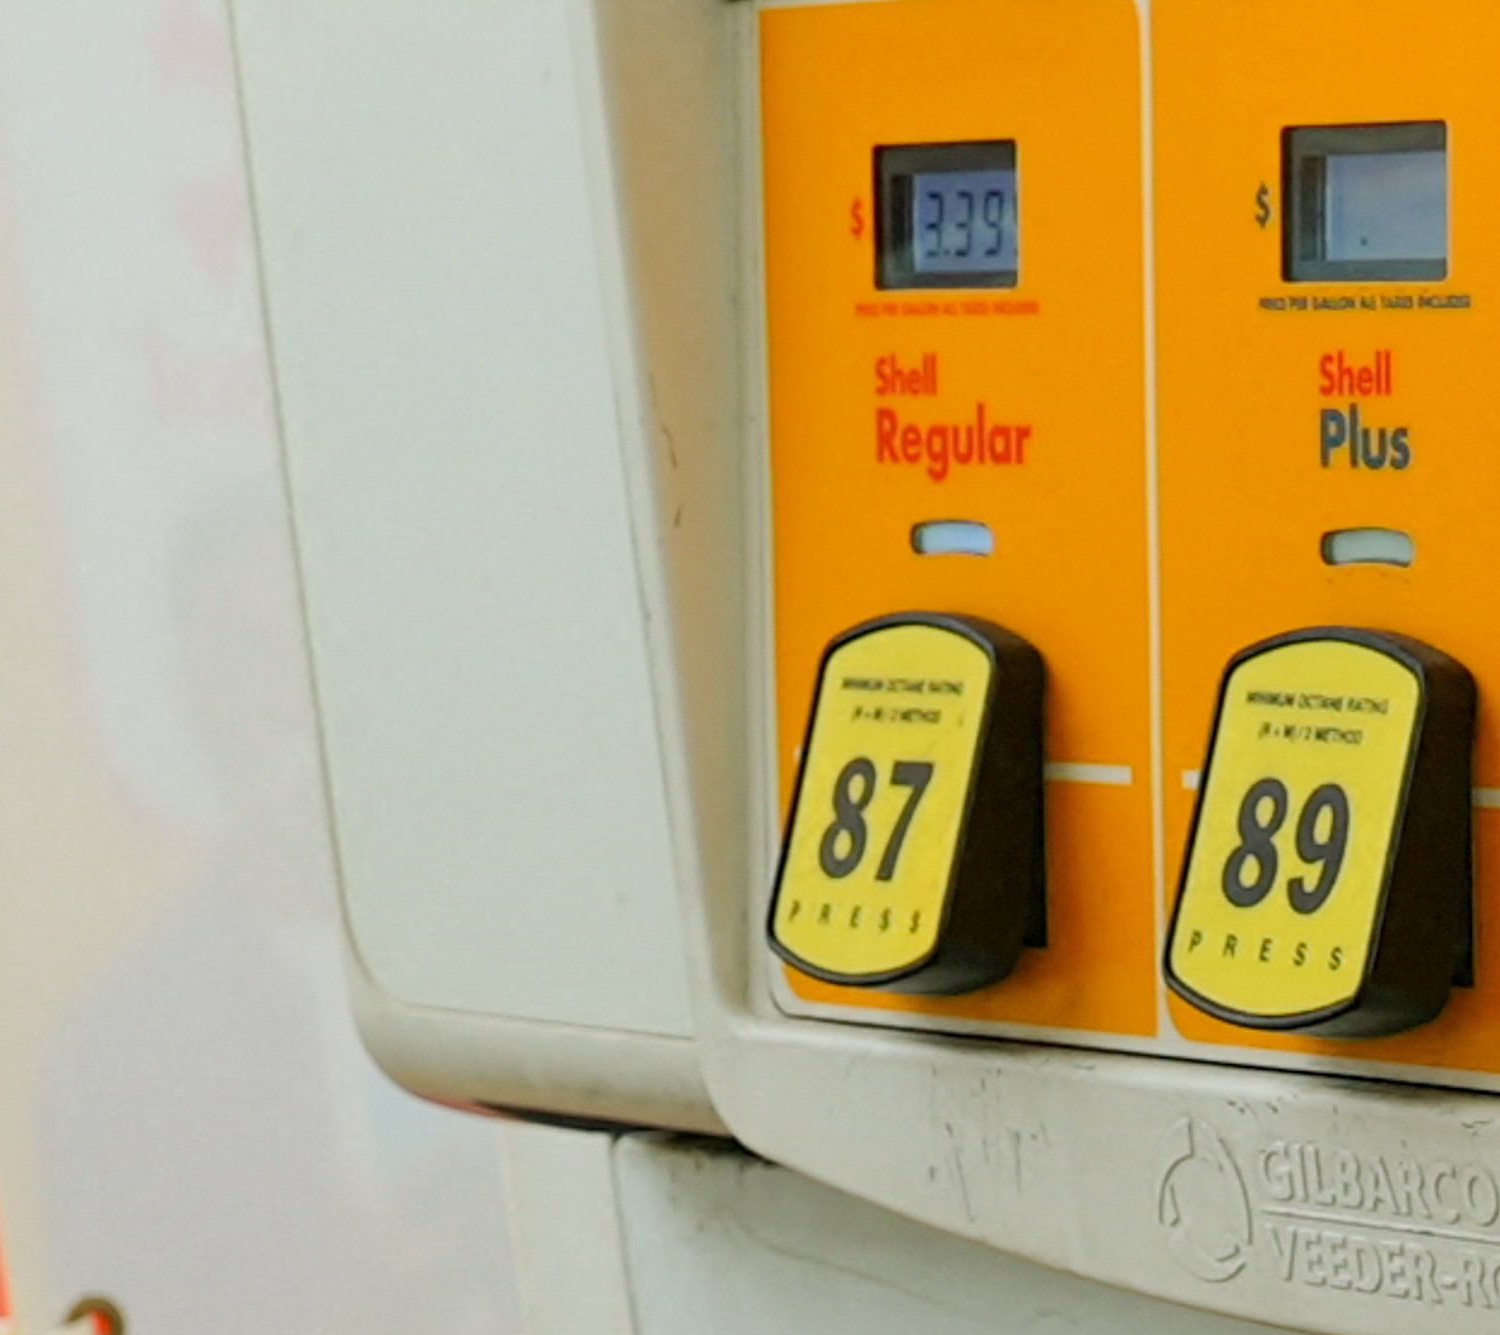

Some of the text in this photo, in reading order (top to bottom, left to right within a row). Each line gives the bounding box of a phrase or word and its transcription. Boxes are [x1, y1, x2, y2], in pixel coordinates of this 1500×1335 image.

[851, 196, 864, 239] $
[1255, 182, 1270, 228] $
[875, 355, 937, 396] Shell
[1319, 350, 1392, 396] Shell
[875, 403, 1031, 482] Regular
[1319, 404, 1411, 470] Plus
[817, 756, 935, 882] 87
[1222, 778, 1350, 914] 89
[1259, 1140, 1500, 1228] GILBARCO
